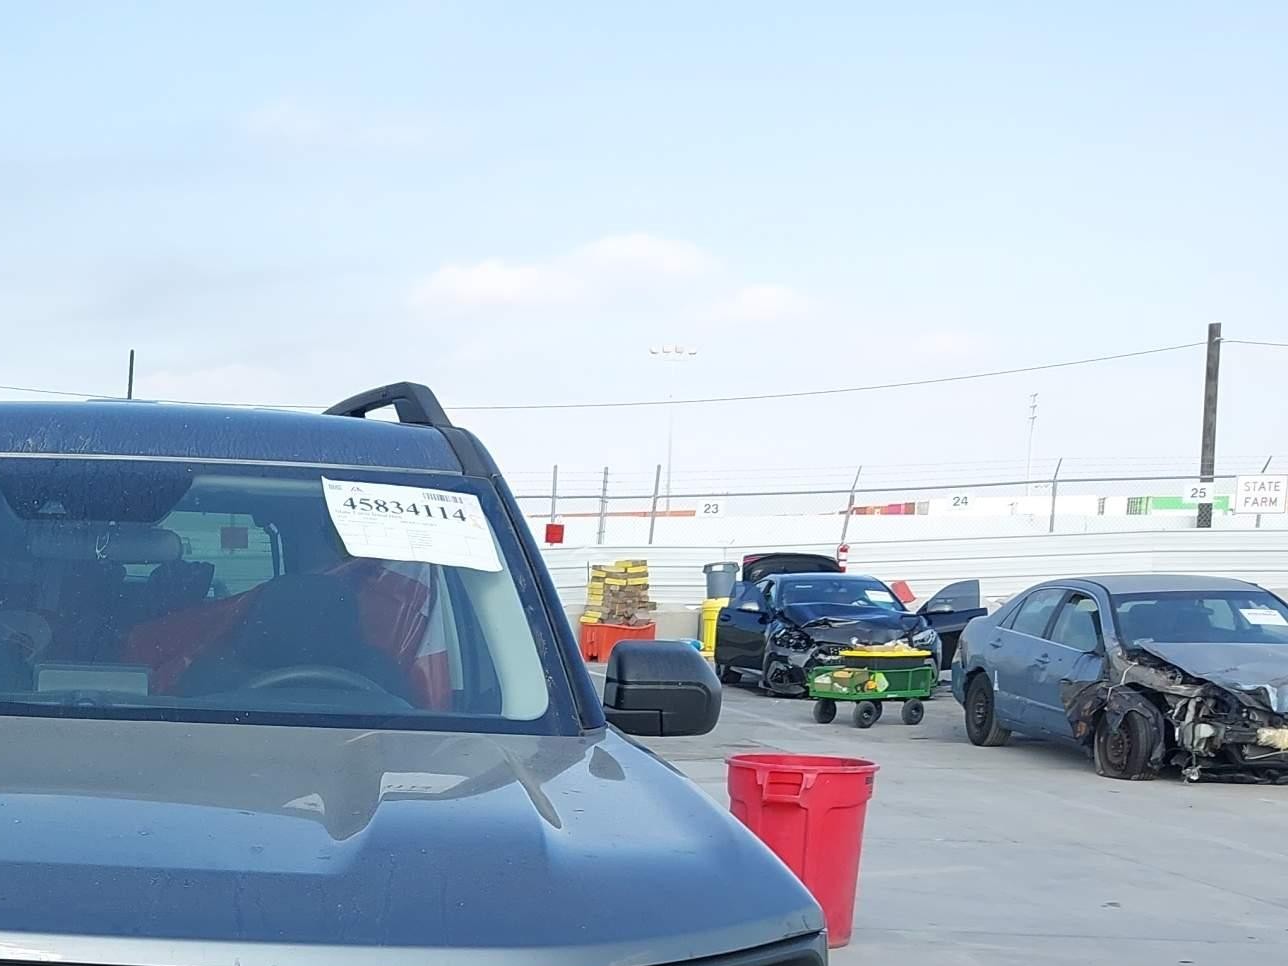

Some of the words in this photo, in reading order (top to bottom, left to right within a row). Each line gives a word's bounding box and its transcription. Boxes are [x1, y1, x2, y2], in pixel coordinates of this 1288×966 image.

[1190, 487, 1207, 499] 25
[1243, 481, 1281, 493] STATE
[952, 496, 969, 507] 24
[1243, 496, 1279, 508] FARM
[343, 497, 467, 522] 45834114
[703, 503, 720, 514] 23
